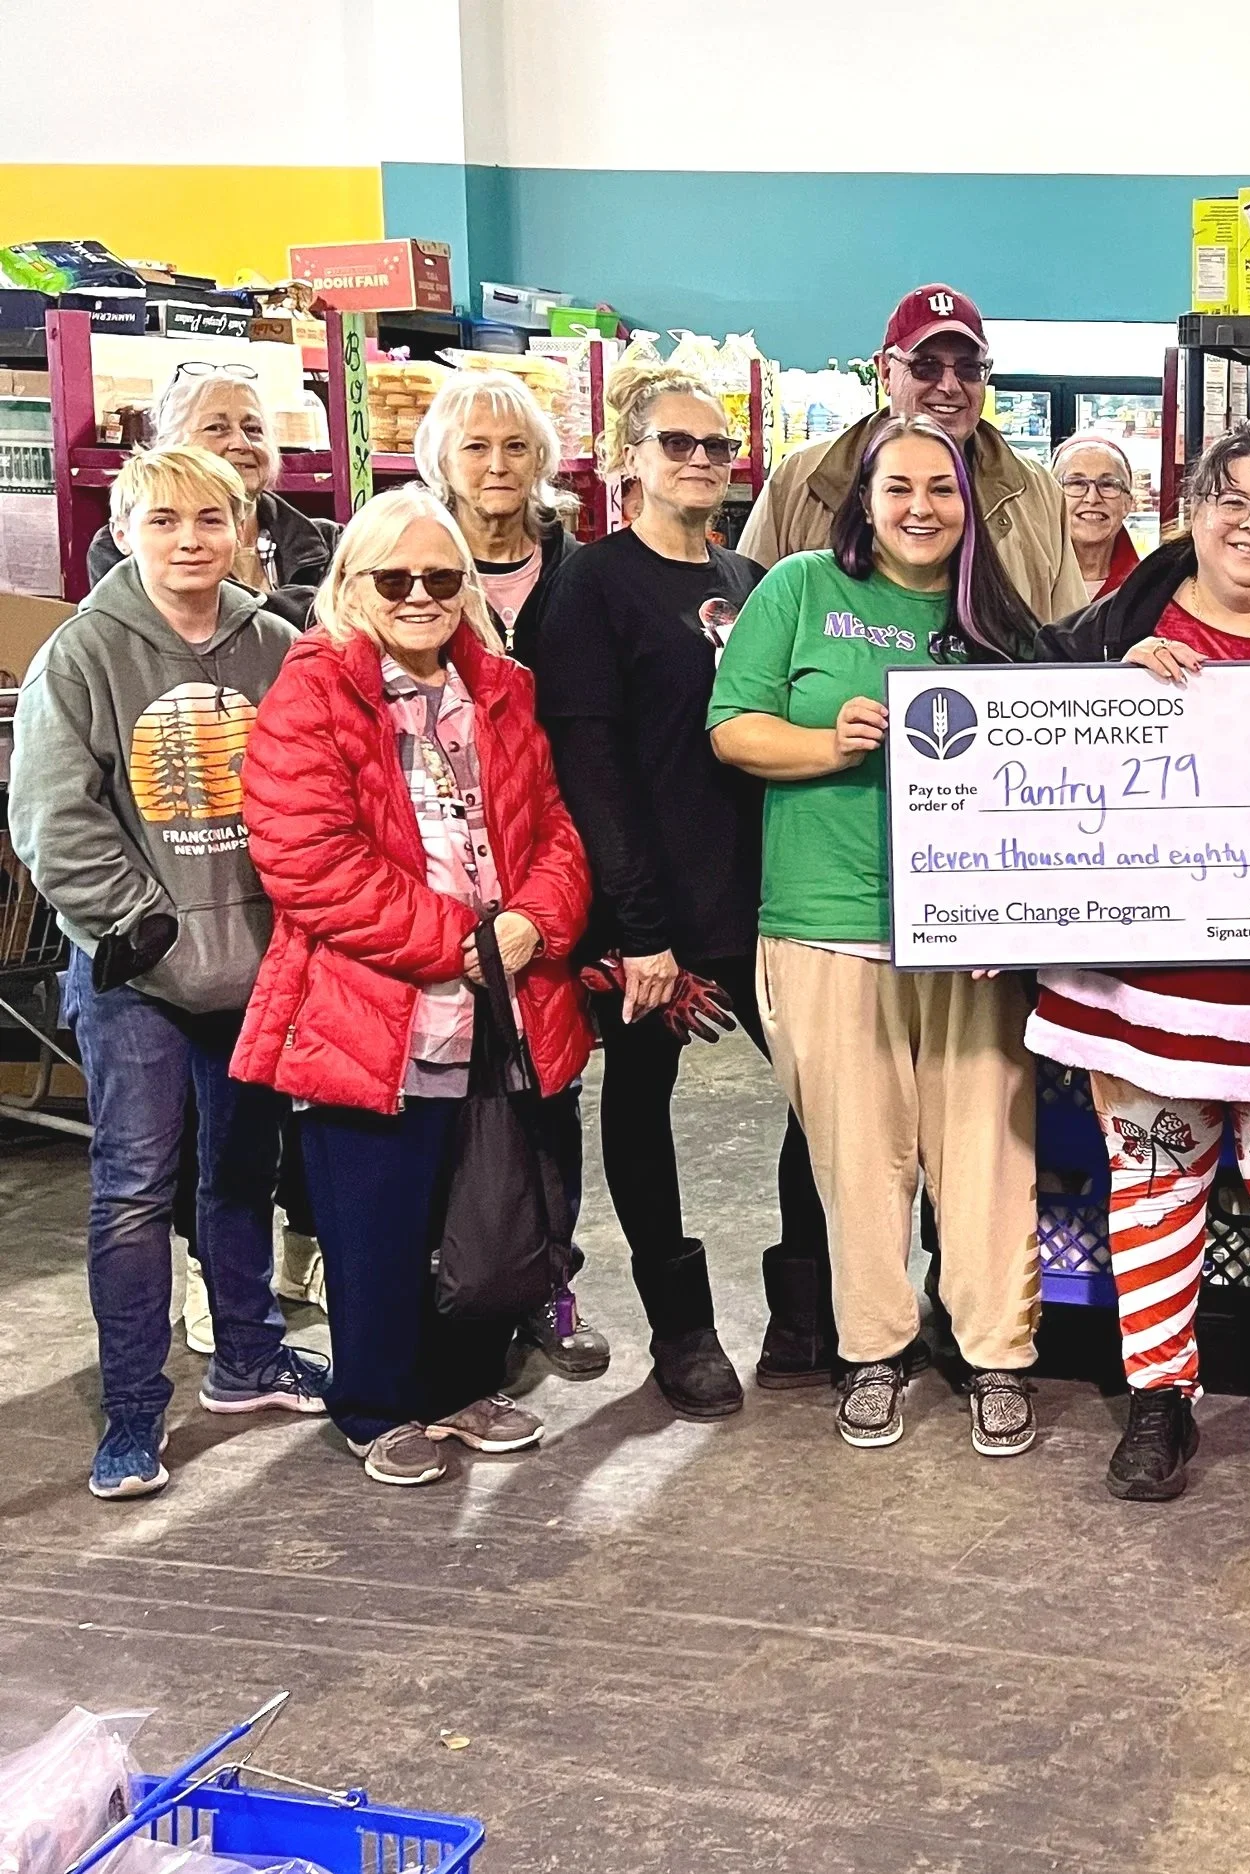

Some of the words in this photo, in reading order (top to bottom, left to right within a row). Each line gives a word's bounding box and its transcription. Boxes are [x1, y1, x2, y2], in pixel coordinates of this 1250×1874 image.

[355, 274, 389, 288] FAIR
[91, 311, 136, 322] HAMMERM
[824, 612, 916, 651] Max's
[987, 699, 1184, 719] BLOOMINGFOODS
[987, 727, 1066, 746] CO-OP
[1075, 726, 1168, 745] MARKET
[909, 784, 933, 799] Pay
[936, 785, 951, 796] to
[955, 783, 977, 796] the
[993, 760, 1107, 835] Pantry
[1121, 753, 1200, 801] 279
[909, 800, 947, 812] order
[951, 799, 965, 811] of
[162, 827, 237, 844] FRANCONIA
[174, 843, 205, 856] NEW
[207, 838, 248, 854] HAMPS
[910, 844, 990, 872] eleven
[995, 838, 1105, 870] thousand
[1117, 844, 1160, 866] and
[924, 903, 999, 923] Positive
[1006, 901, 1080, 926] Change
[1087, 901, 1171, 926] Program
[913, 931, 957, 944] Memo
